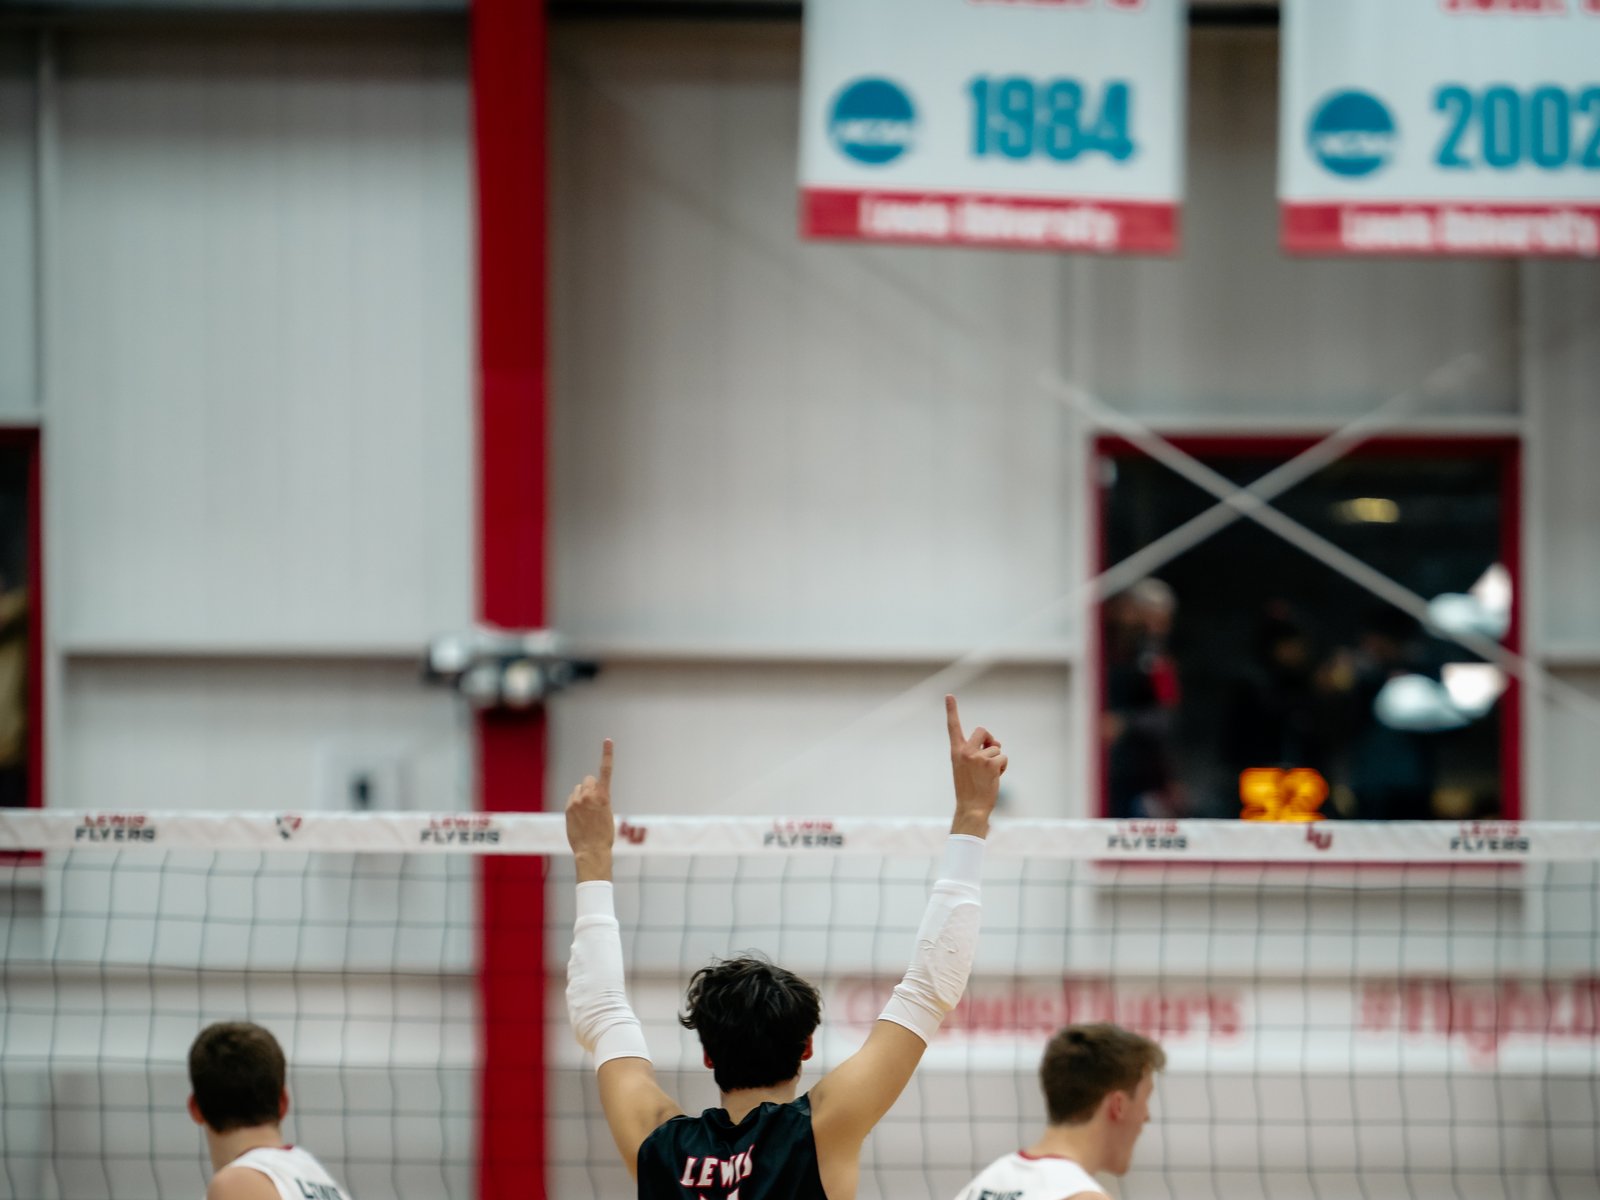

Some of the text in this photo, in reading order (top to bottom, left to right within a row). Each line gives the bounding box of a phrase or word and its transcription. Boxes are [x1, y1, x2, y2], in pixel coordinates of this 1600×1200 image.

[968, 77, 1133, 161] 1984
[1434, 85, 1600, 168] 2002
[75, 828, 155, 842] FLYERS
[420, 831, 500, 844] FLYERS
[763, 834, 843, 849] FLYERS
[1107, 837, 1187, 851] FLYERS
[1450, 838, 1530, 852] FLYERS
[680, 1144, 755, 1188] LEWIS
